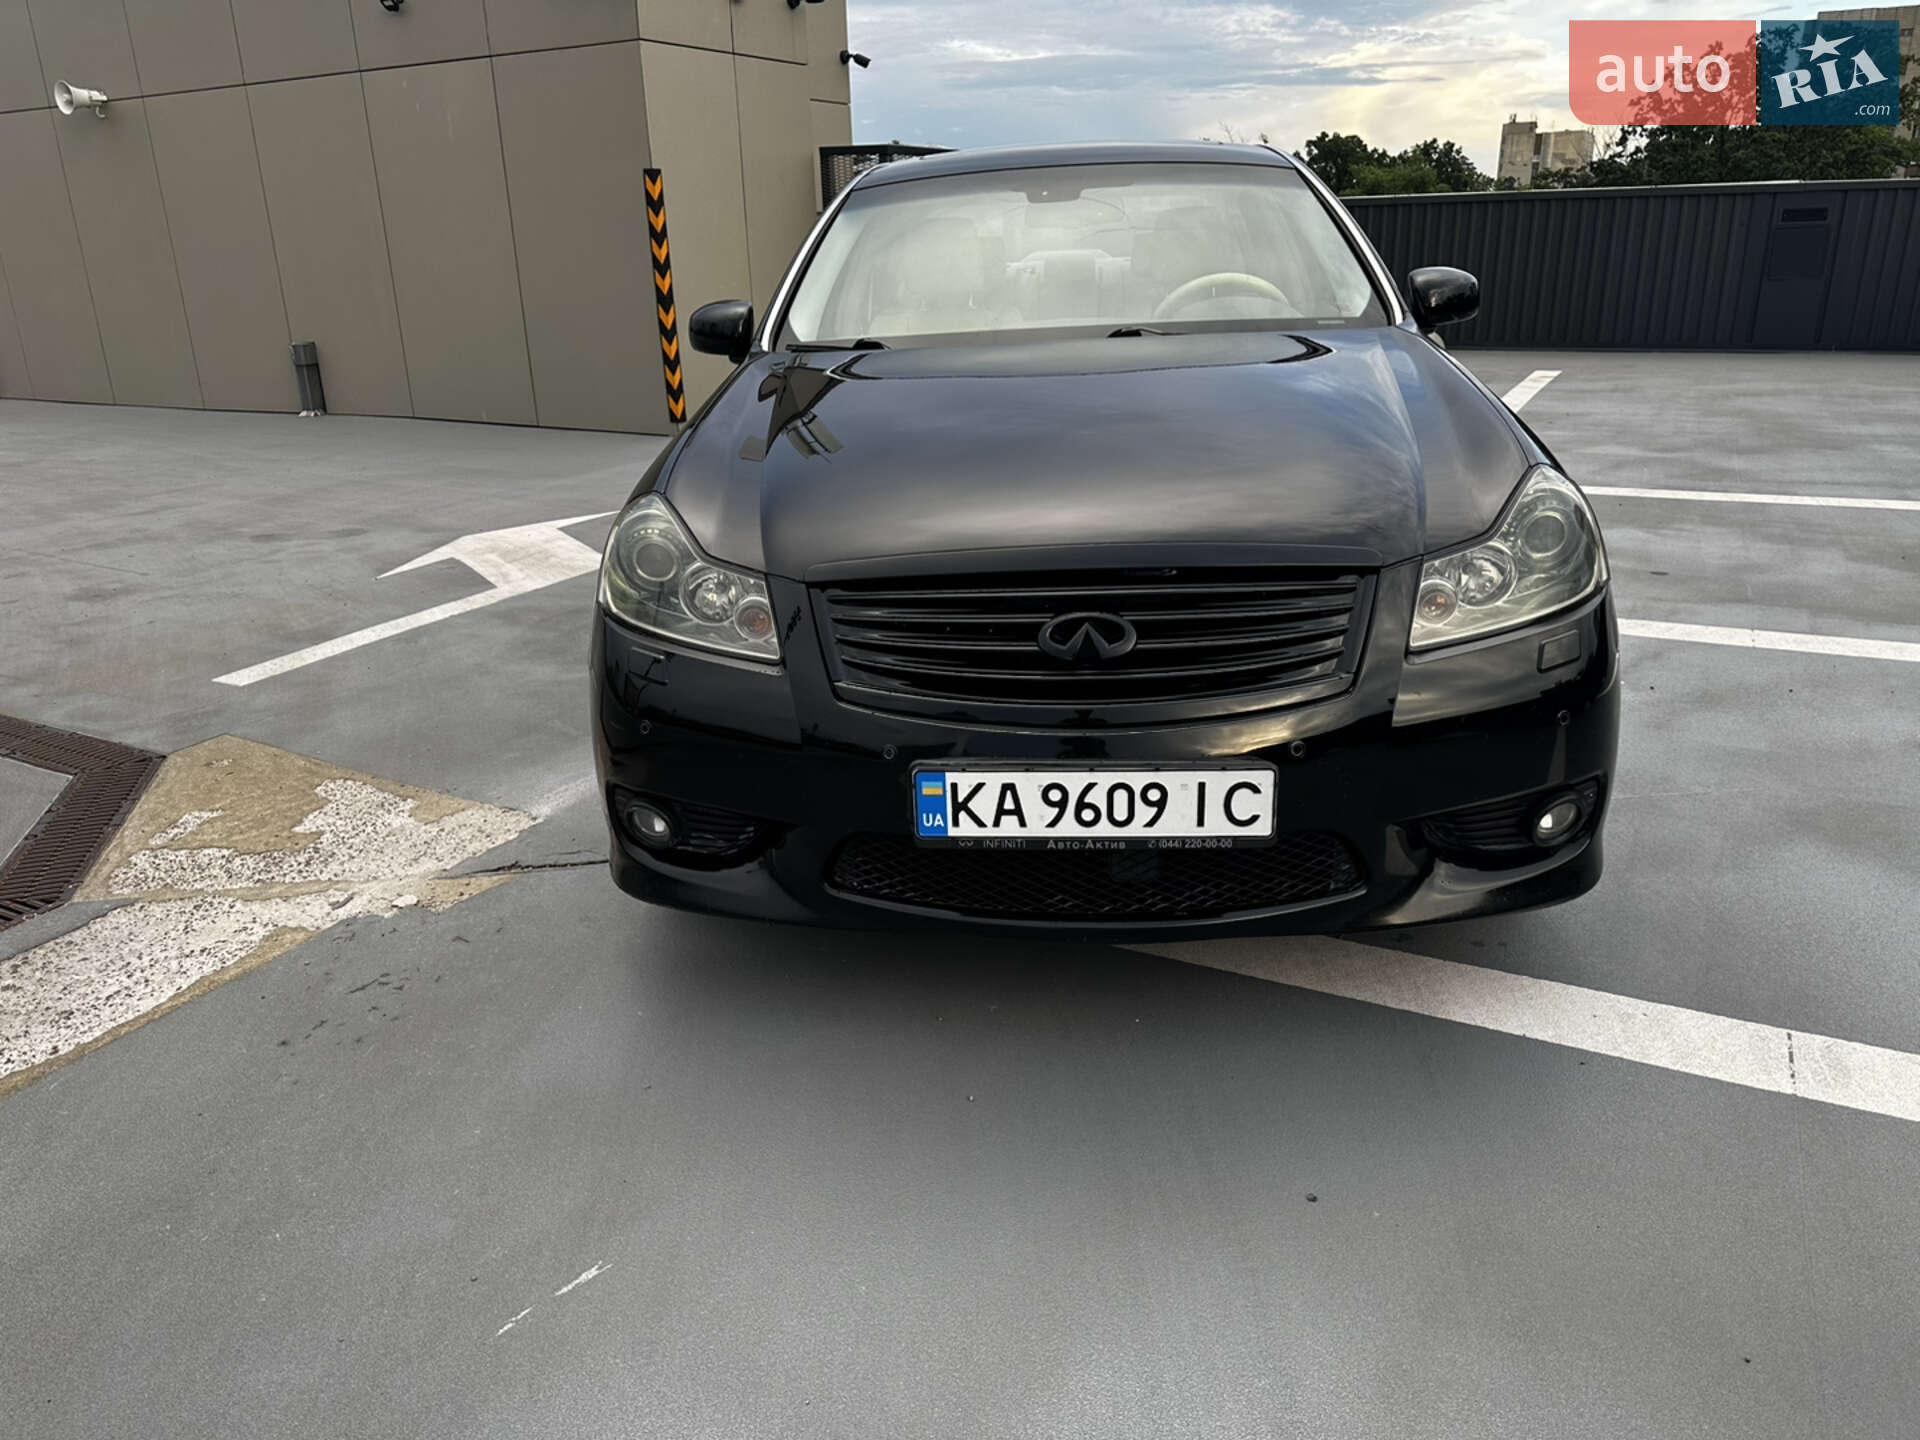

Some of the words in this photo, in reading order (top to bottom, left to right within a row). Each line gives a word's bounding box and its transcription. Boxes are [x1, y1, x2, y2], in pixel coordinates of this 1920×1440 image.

[950, 781, 1027, 829] KA
[1041, 781, 1169, 829] 9609
[1196, 781, 1263, 829] IC
[922, 813, 945, 827] UA
[982, 839, 1027, 848] INFINITI
[1184, 838, 1233, 848] 220-00-00
